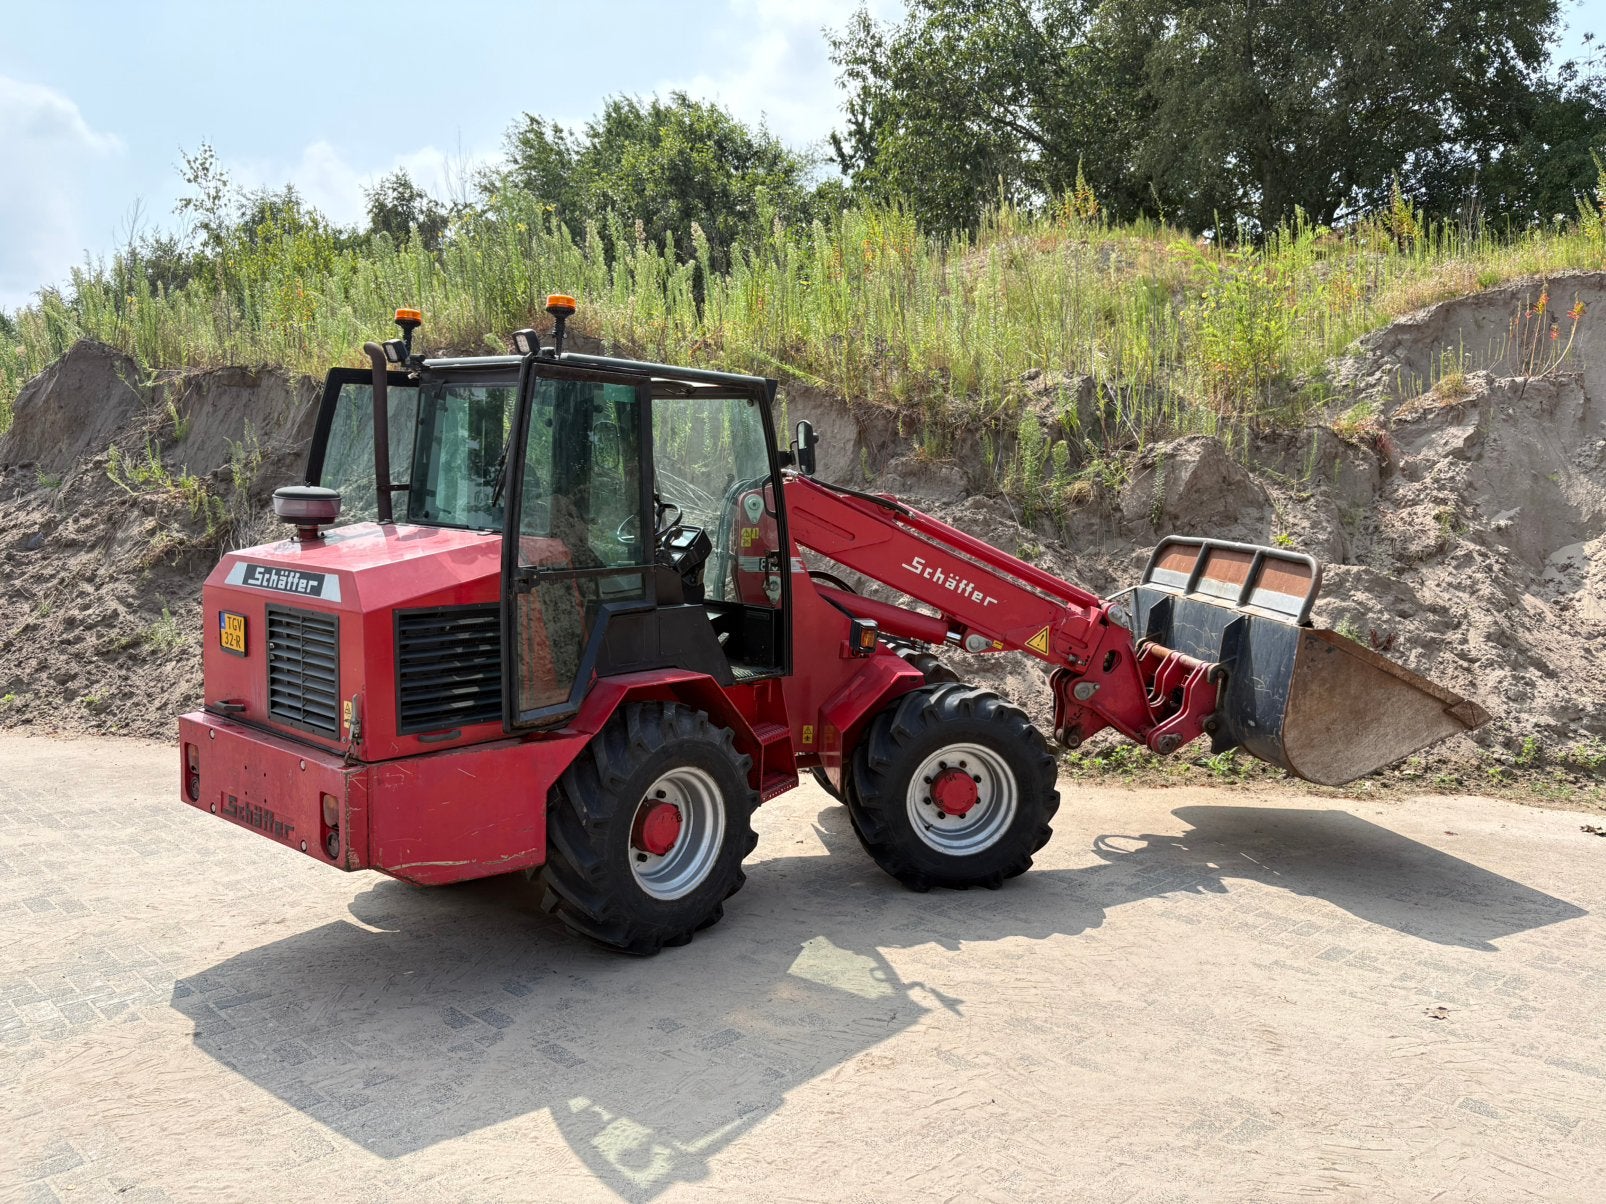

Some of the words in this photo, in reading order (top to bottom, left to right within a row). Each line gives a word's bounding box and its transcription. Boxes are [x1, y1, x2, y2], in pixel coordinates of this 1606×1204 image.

[247, 567, 319, 593] Schäffer
[901, 556, 998, 607] Schäffer
[226, 616, 242, 632] TGV
[225, 632, 241, 649] 32-R
